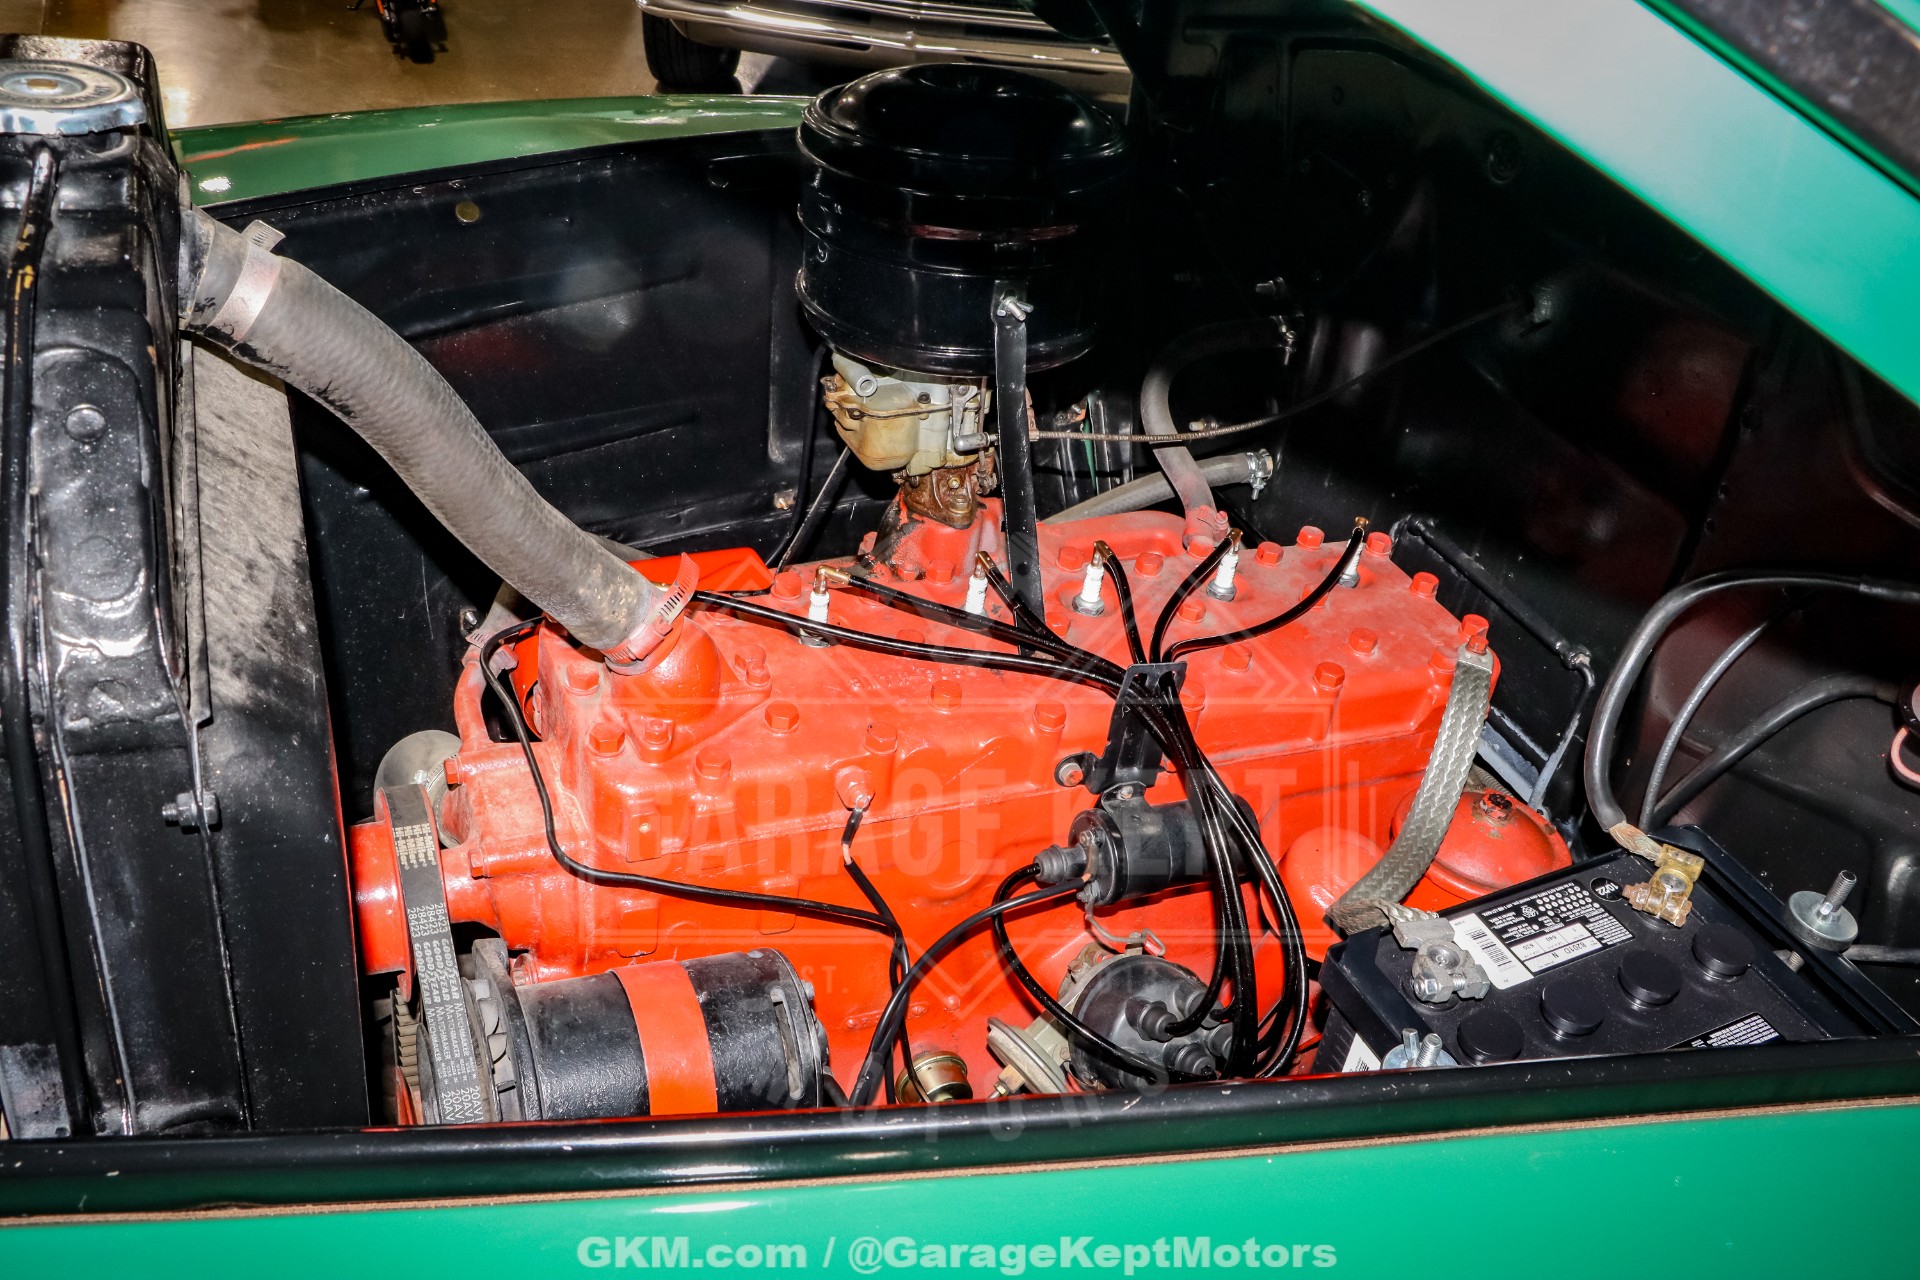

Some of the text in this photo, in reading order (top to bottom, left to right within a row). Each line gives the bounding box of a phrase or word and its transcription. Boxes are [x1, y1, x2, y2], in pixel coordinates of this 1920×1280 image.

[1595, 882, 1619, 896] 10/22
[417, 906, 430, 937] 28423
[426, 904, 439, 935] 28423
[407, 907, 421, 938] 28423
[414, 943, 432, 1005] GOODYEAR
[423, 942, 441, 1003] GOODYEAR
[432, 940, 451, 1001] GOODYEAR
[435, 903, 448, 933] 28423
[442, 938, 460, 1000] GOODYEAR
[450, 1089, 465, 1123] 20AV
